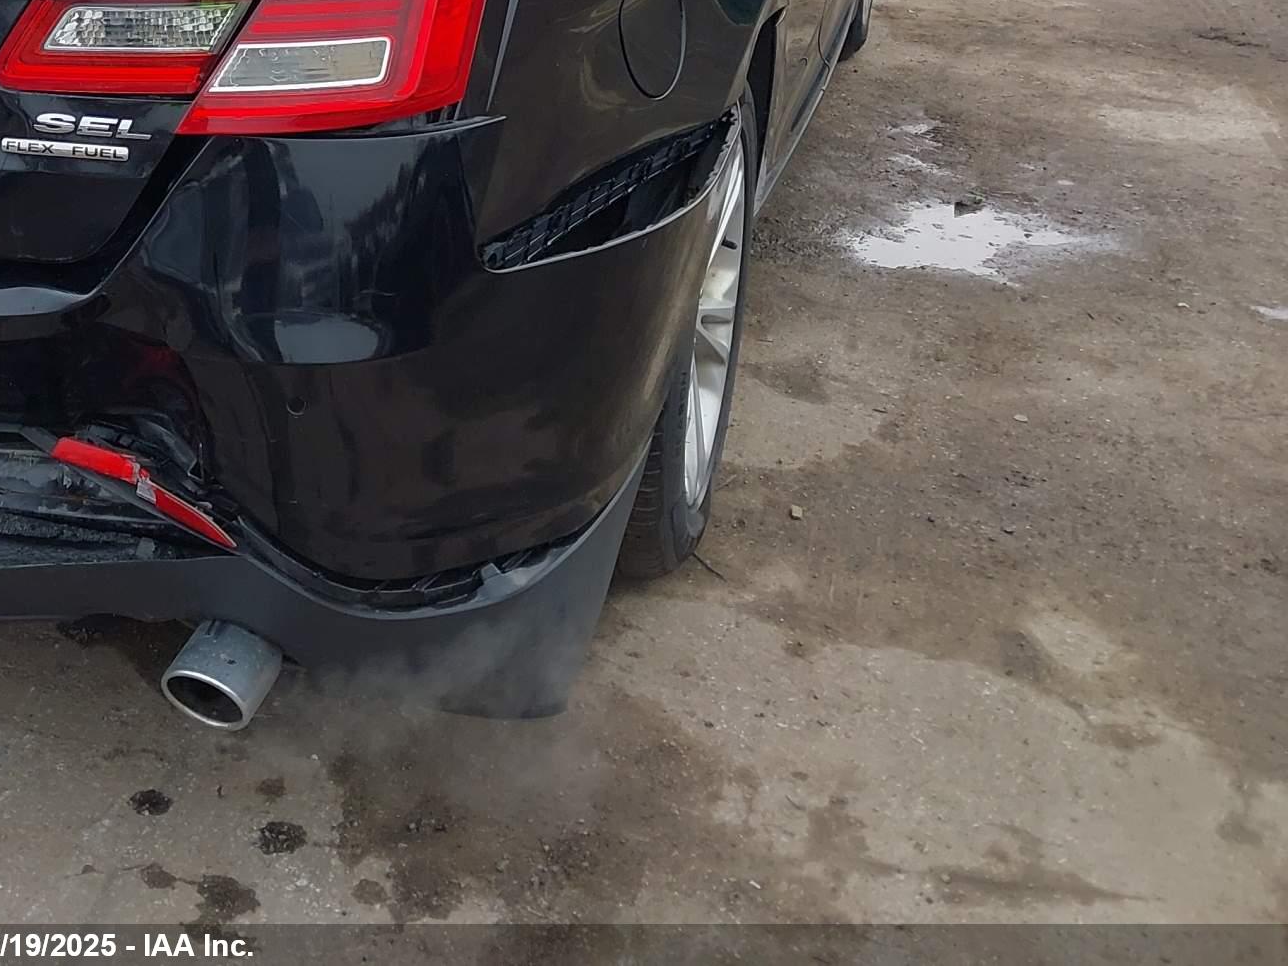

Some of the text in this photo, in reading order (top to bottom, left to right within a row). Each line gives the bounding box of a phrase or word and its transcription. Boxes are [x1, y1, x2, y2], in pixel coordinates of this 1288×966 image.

[33, 113, 152, 140] SEL
[5, 140, 125, 160] FLEX FUEL
